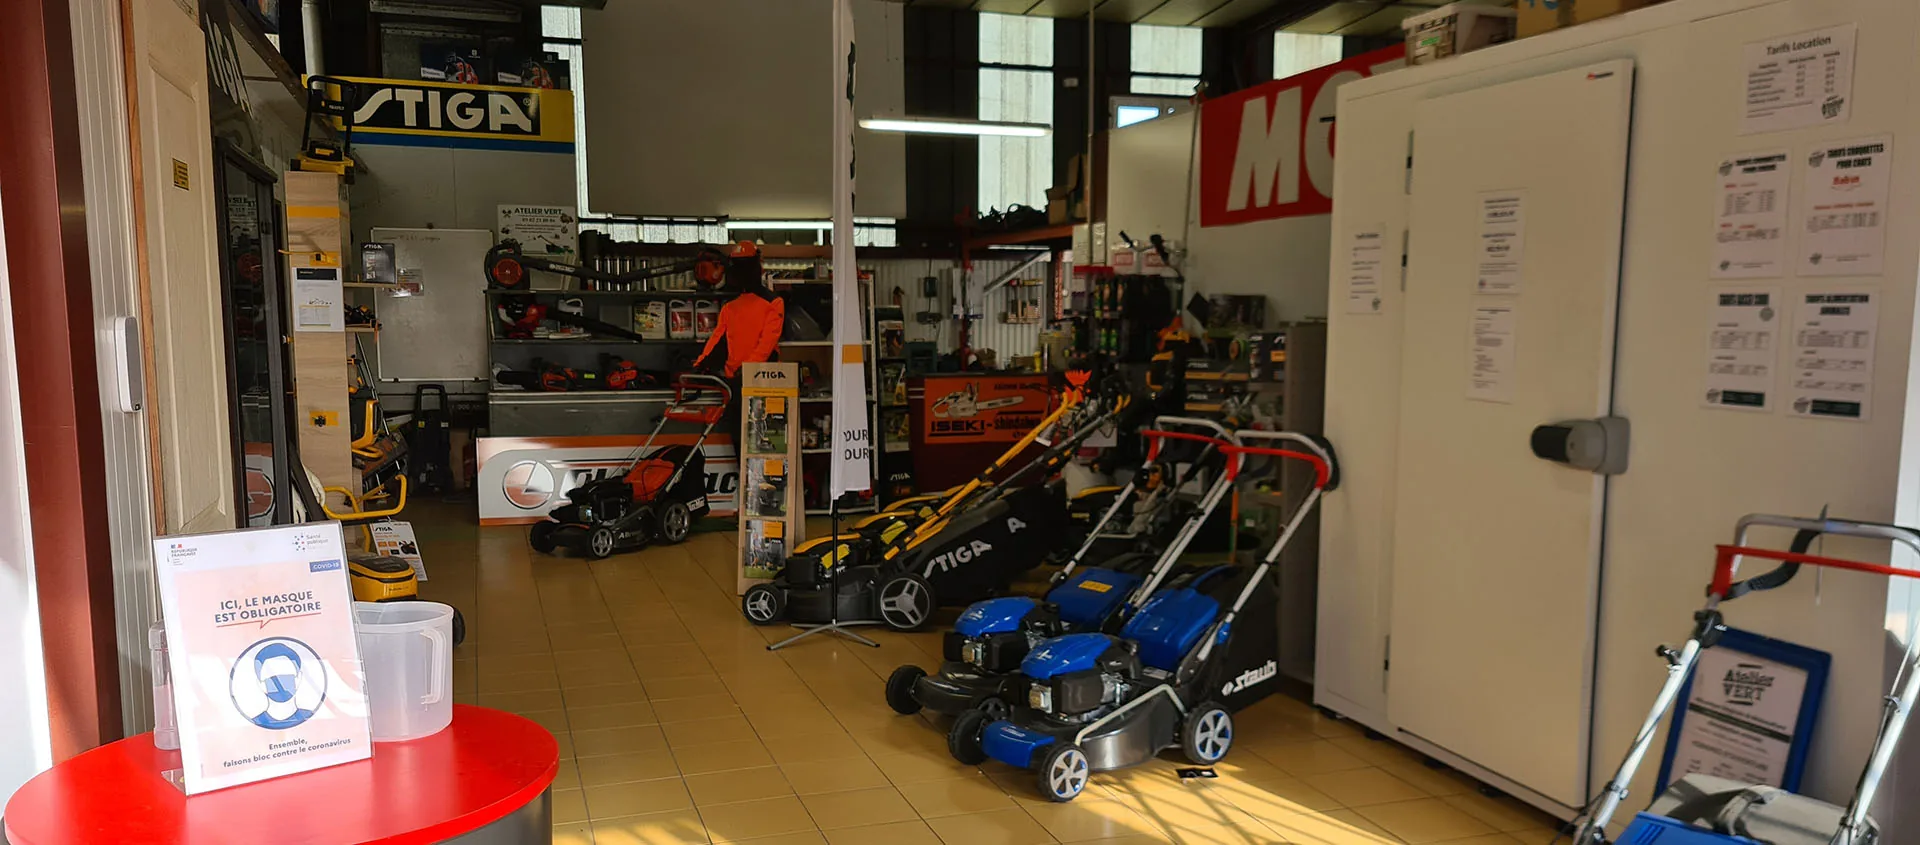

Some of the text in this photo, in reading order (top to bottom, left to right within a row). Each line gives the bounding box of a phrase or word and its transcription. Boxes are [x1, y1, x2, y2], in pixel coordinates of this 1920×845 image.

[1792, 36, 1831, 51] Location
[353, 88, 532, 132] STIGA
[514, 207, 543, 215] ATELIER
[754, 371, 786, 379] STIGA
[923, 539, 993, 580] STIGA
[220, 591, 313, 610] ICI, LE MASQUE
[215, 601, 322, 623] EST OBLIGATOIRE
[1723, 683, 1765, 700] VERT
[223, 758, 252, 767] faisons
[253, 753, 271, 762] bloc
[272, 749, 298, 759] contre
[307, 738, 351, 752] coronavirus
[269, 738, 308, 750] Ensemble,
